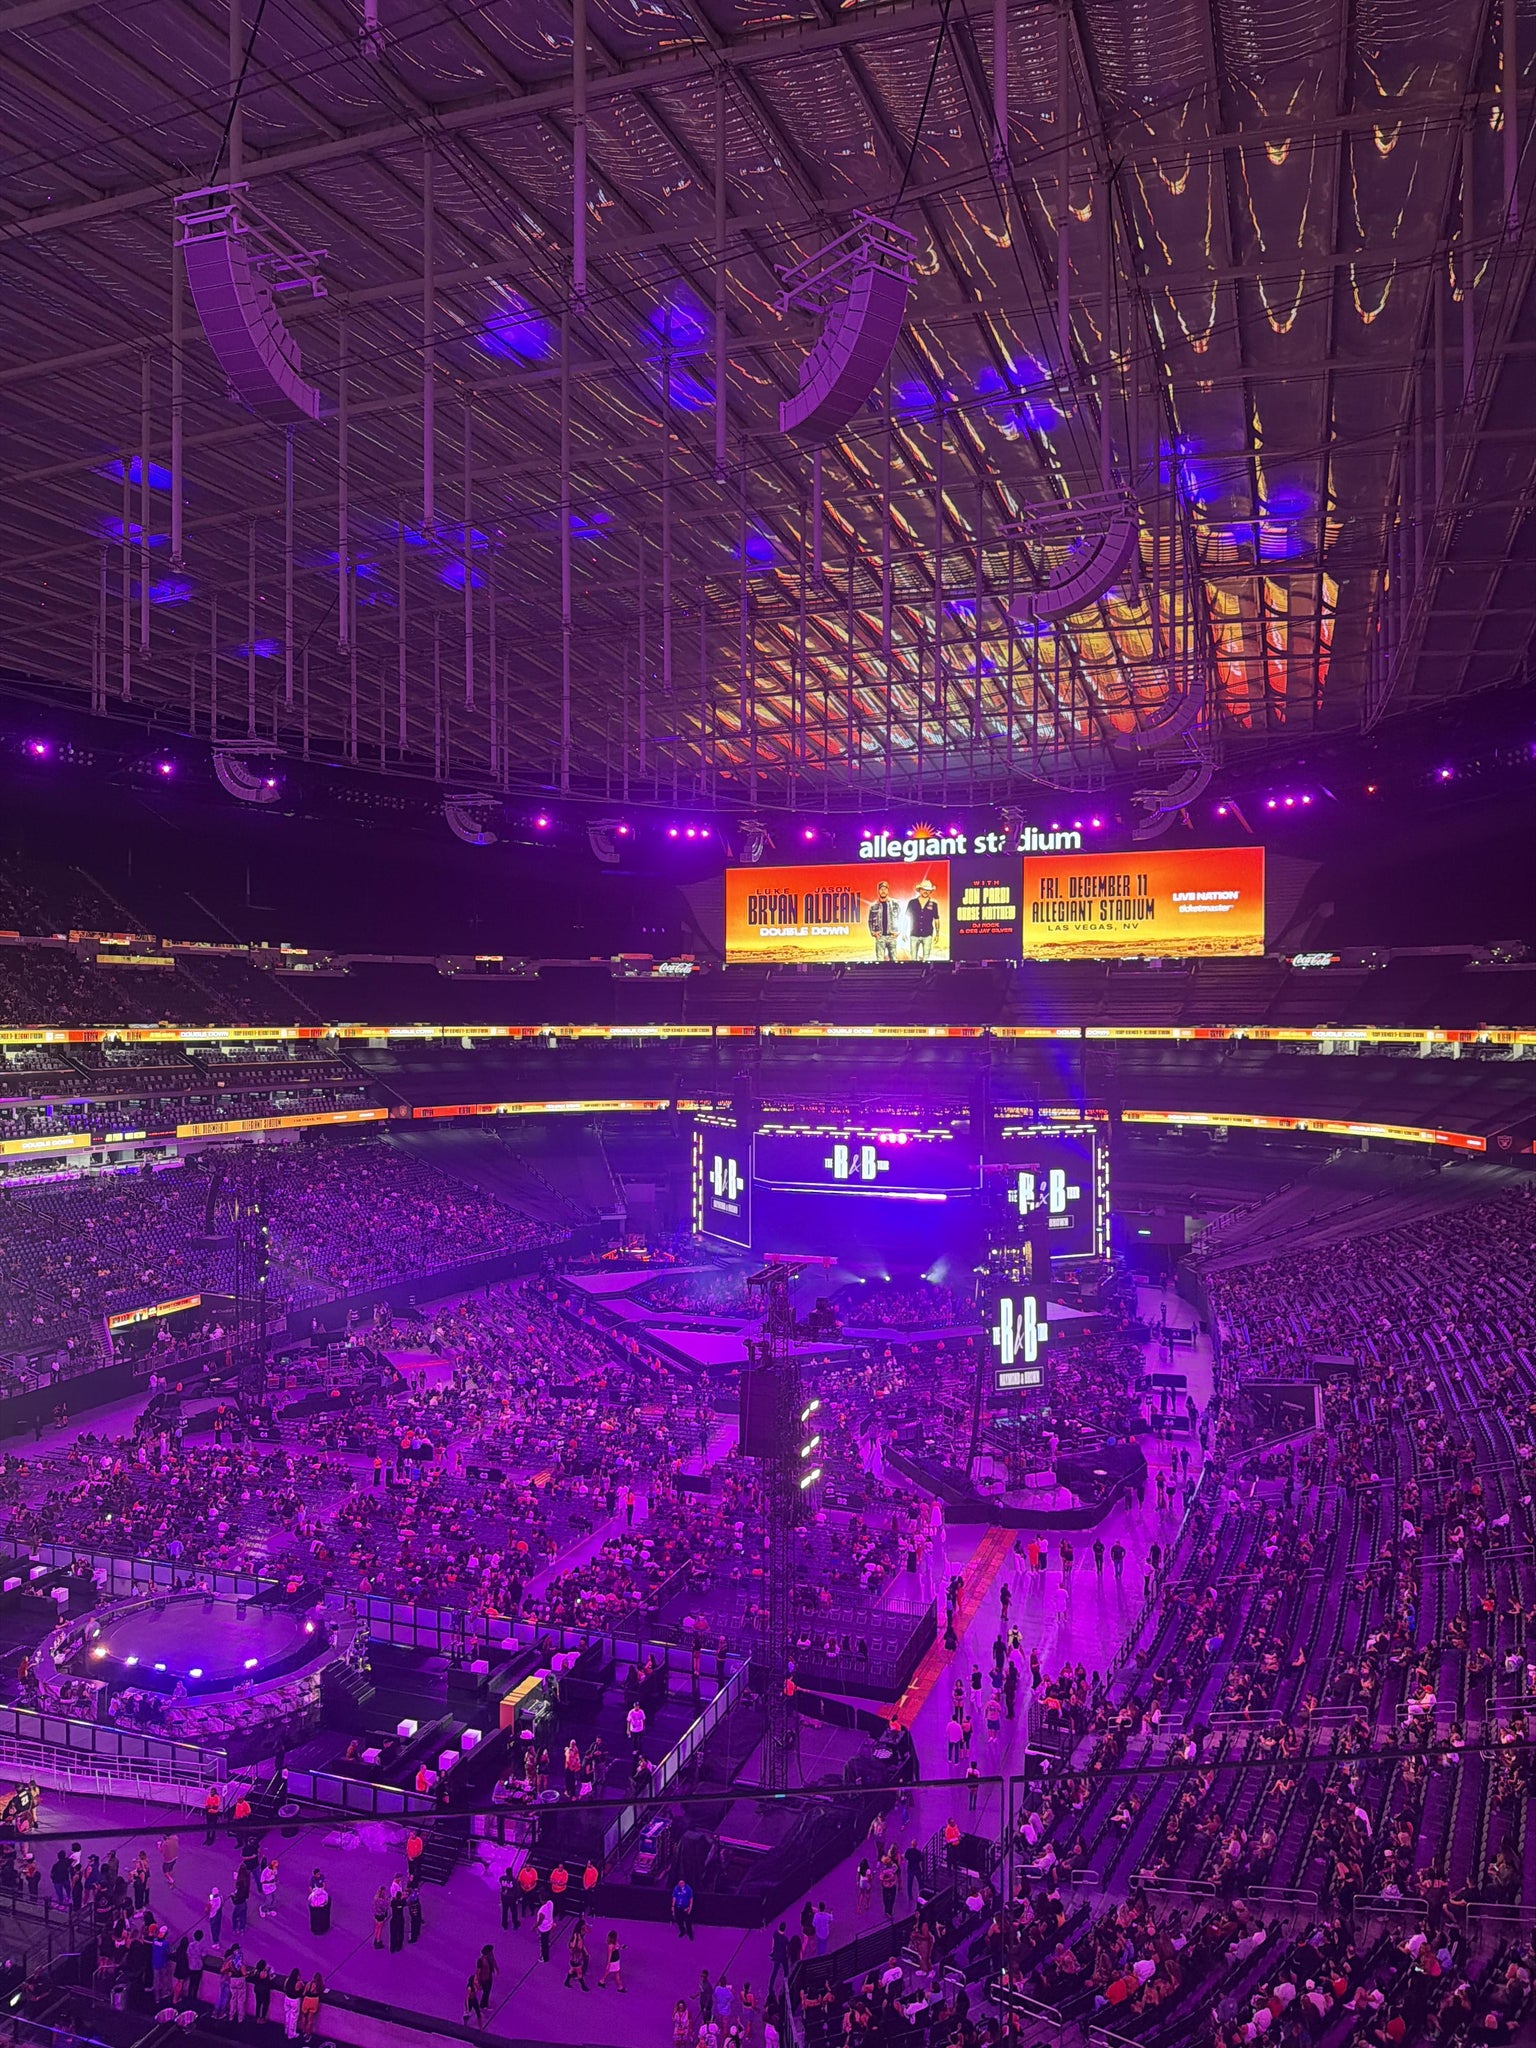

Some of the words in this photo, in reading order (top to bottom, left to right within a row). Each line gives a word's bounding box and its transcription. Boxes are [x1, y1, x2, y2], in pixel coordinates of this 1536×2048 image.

[859, 833, 967, 862] allegiant
[1040, 878, 1062, 899] FRI.
[1069, 875, 1130, 898] DECEMBER
[1137, 874, 1148, 896] 11
[1172, 892, 1196, 902] LIVE
[1196, 891, 1239, 901] NATION
[748, 894, 798, 925] BRYAN
[804, 892, 861, 924] ALDEAN
[1032, 900, 1093, 923] ALLEGIANT
[1100, 898, 1155, 921] STADIUM
[1178, 904, 1234, 913] ticketmaster
[759, 927, 809, 937] DOUBLE
[811, 926, 850, 935] DOWN
[1074, 923, 1117, 932] VEGAS,
[1123, 922, 1139, 930] NV
[1292, 952, 1334, 967] Coca-Cola
[658, 962, 695, 974] Coca-Cola
